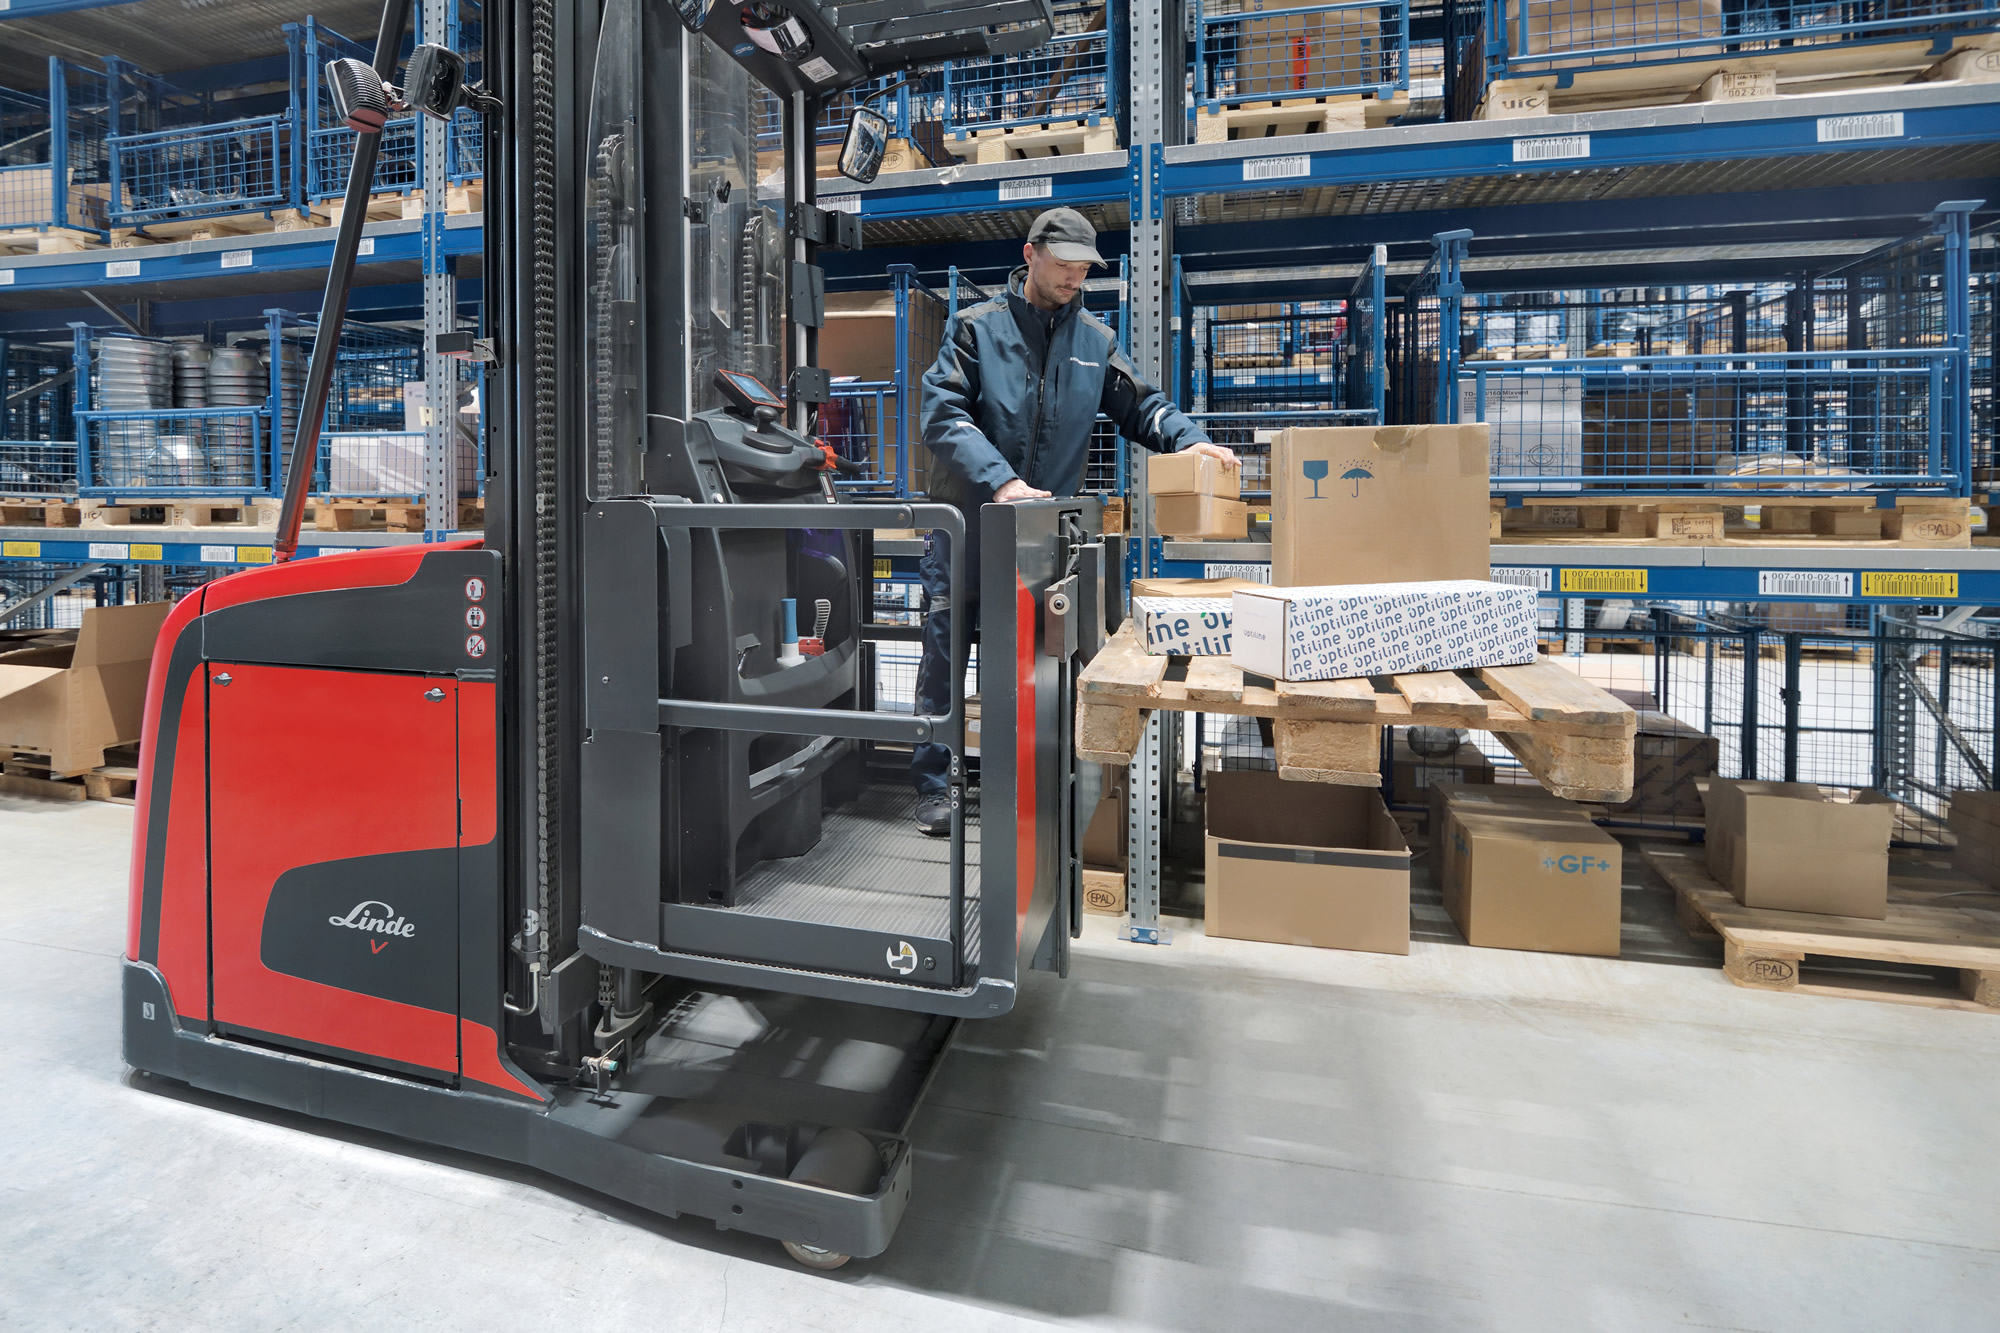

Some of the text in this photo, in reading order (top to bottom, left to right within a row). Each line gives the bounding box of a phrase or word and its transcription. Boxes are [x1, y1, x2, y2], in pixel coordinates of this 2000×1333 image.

[1825, 115, 1894, 127] 007-010-03-1
[1520, 136, 1583, 147] 007-011-03-1
[1248, 156, 1303, 167] 007-012-03-1
[1003, 179, 1047, 188] 007-013-03-1
[818, 196, 856, 205] 007-014-03-1
[1919, 523, 1953, 536] EPAL
[1490, 569, 1540, 577] 7-011-02-1
[1571, 570, 1635, 578] 007-011-01-1
[1771, 573, 1840, 581] 007-010-02-1
[1874, 574, 1945, 582] 007-010-01-1
[1503, 608, 1537, 628] optili
[1291, 634, 1340, 660] ptiline
[1091, 892, 1111, 904] EPAL
[328, 900, 415, 938] Linde
[1755, 963, 1787, 978] EPAL
